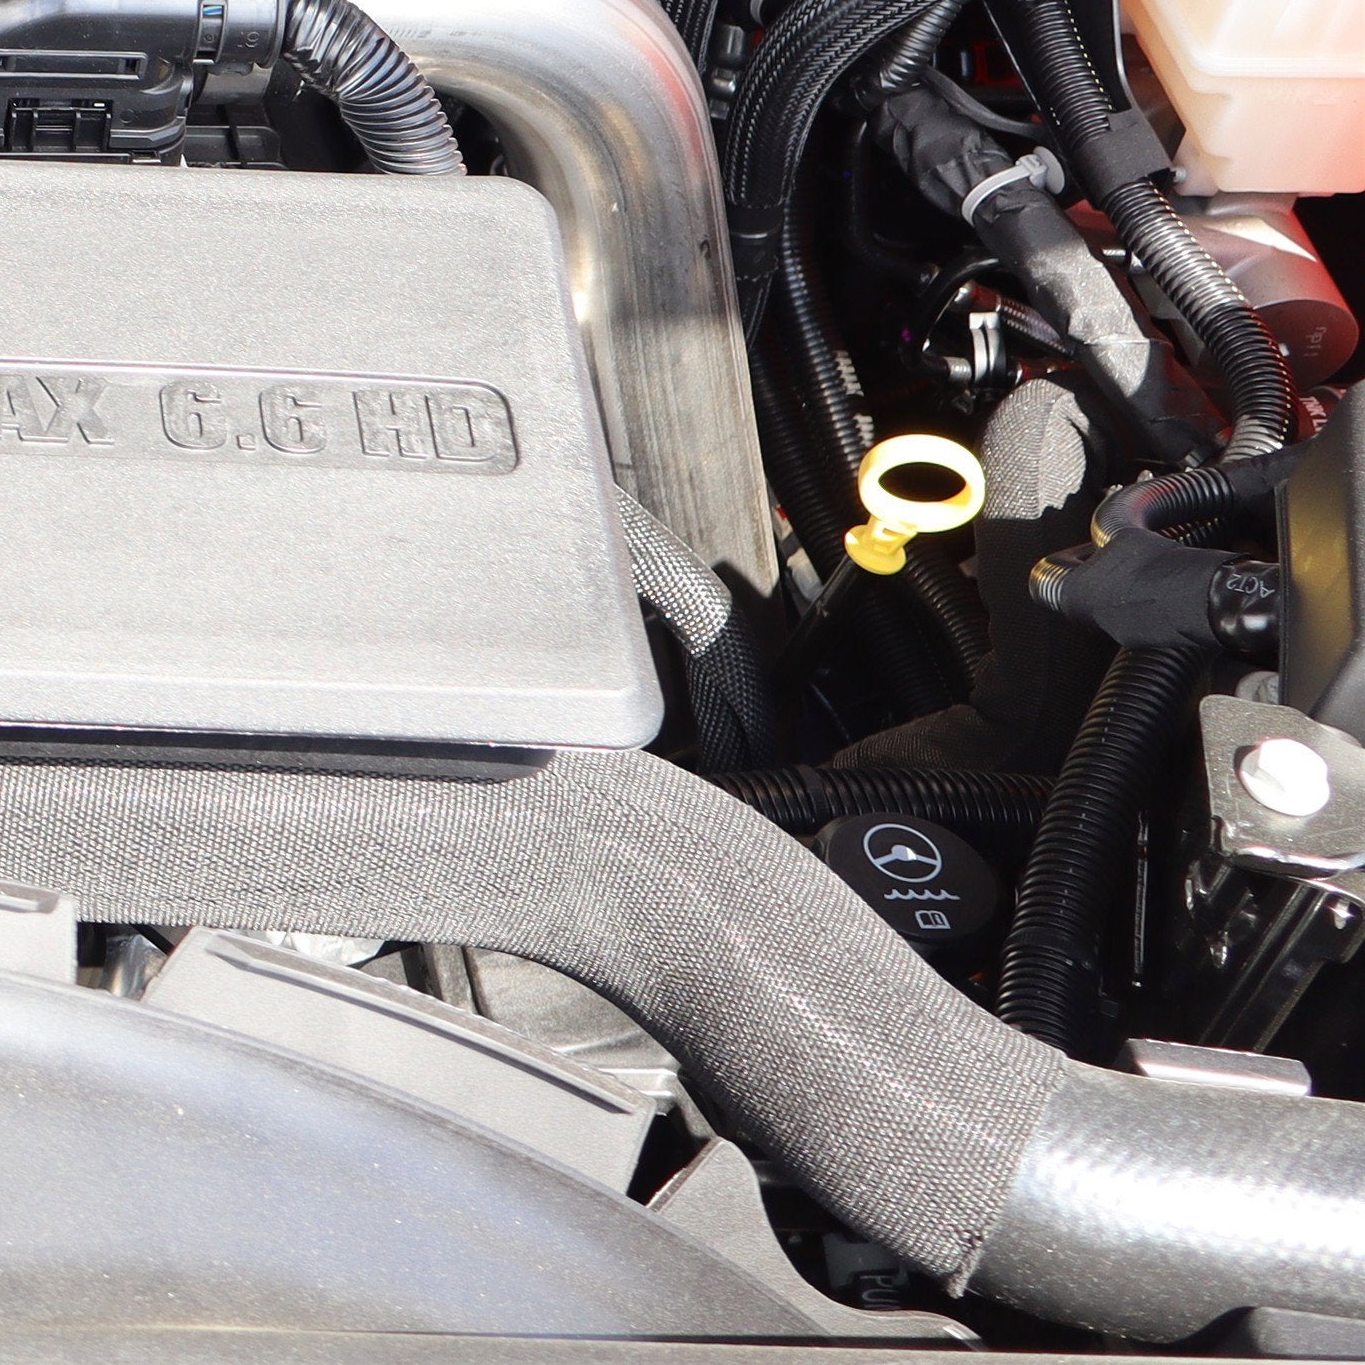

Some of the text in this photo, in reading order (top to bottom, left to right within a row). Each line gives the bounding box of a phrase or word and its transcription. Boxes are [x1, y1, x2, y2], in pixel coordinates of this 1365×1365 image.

[158, 380, 329, 458] 6.6
[355, 388, 517, 467] HD
[1225, 573, 1276, 599] ACT2
